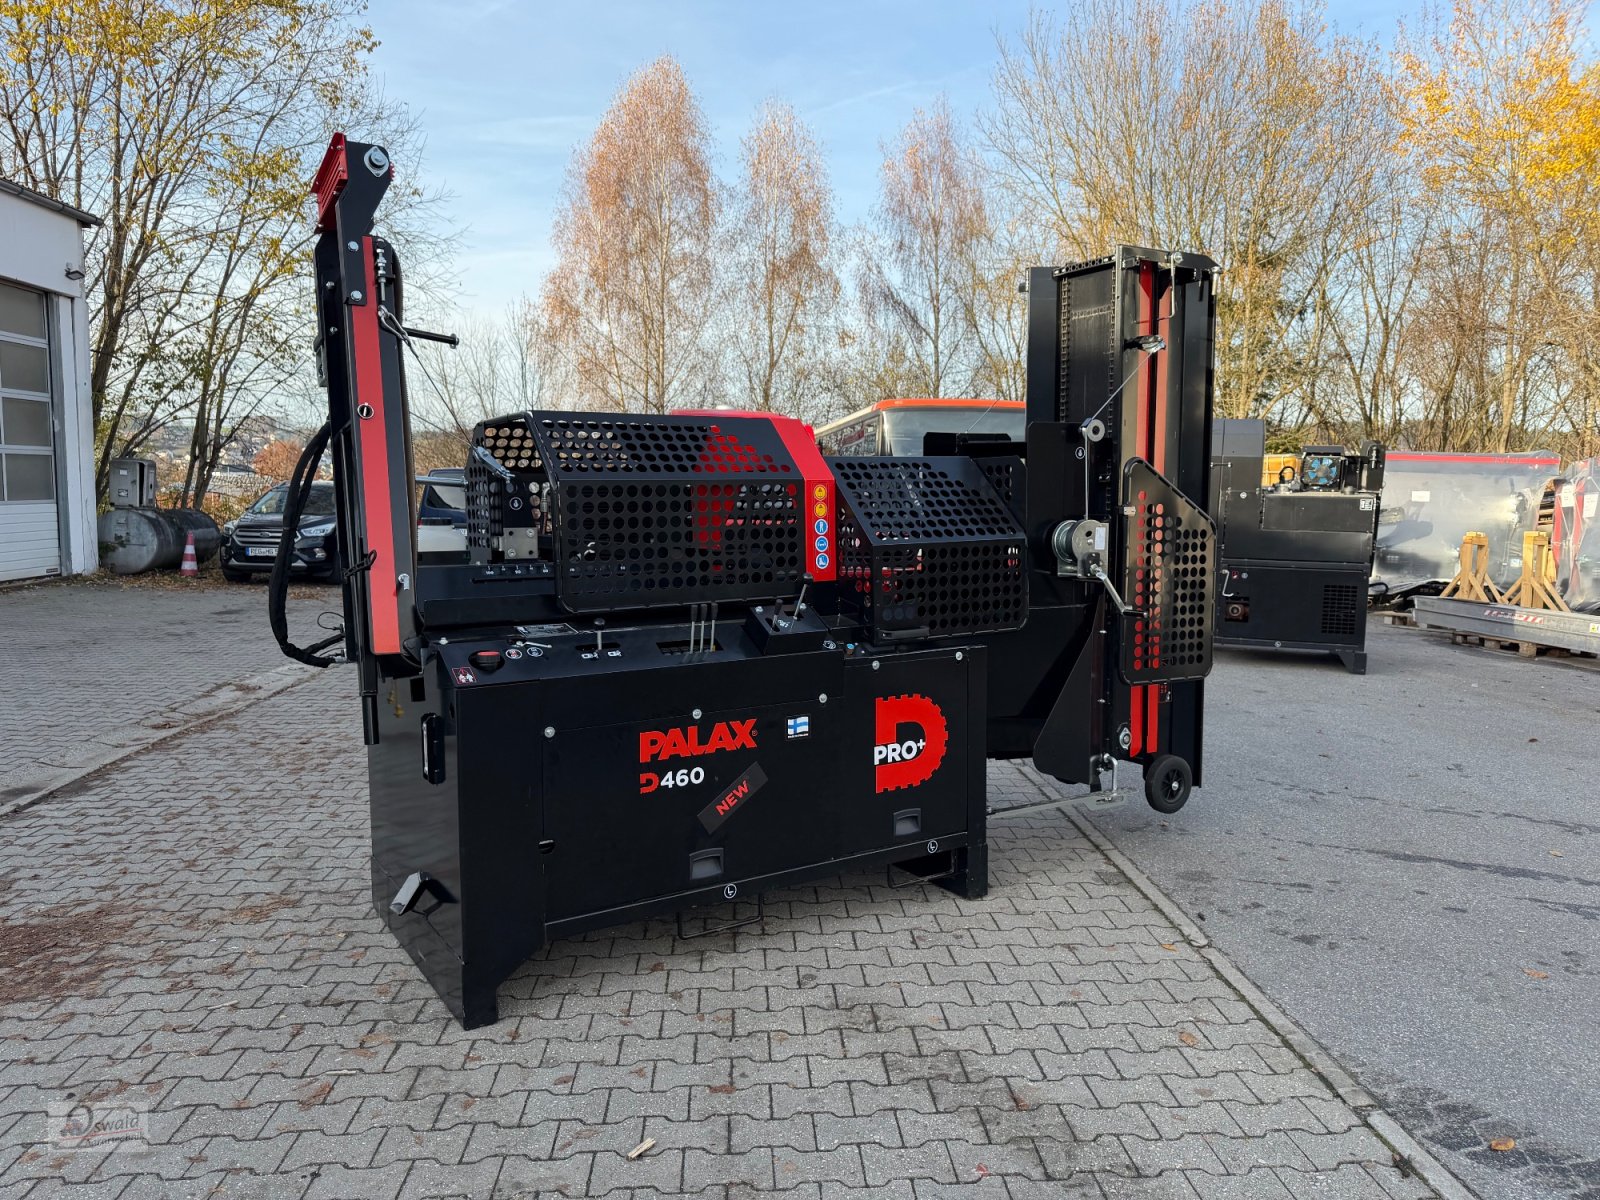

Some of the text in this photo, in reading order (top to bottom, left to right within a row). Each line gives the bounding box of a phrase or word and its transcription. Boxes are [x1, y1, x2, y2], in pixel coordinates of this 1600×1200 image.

[639, 718, 757, 763] PALAX
[873, 738, 926, 766] PRO+
[715, 780, 749, 816] NEW
